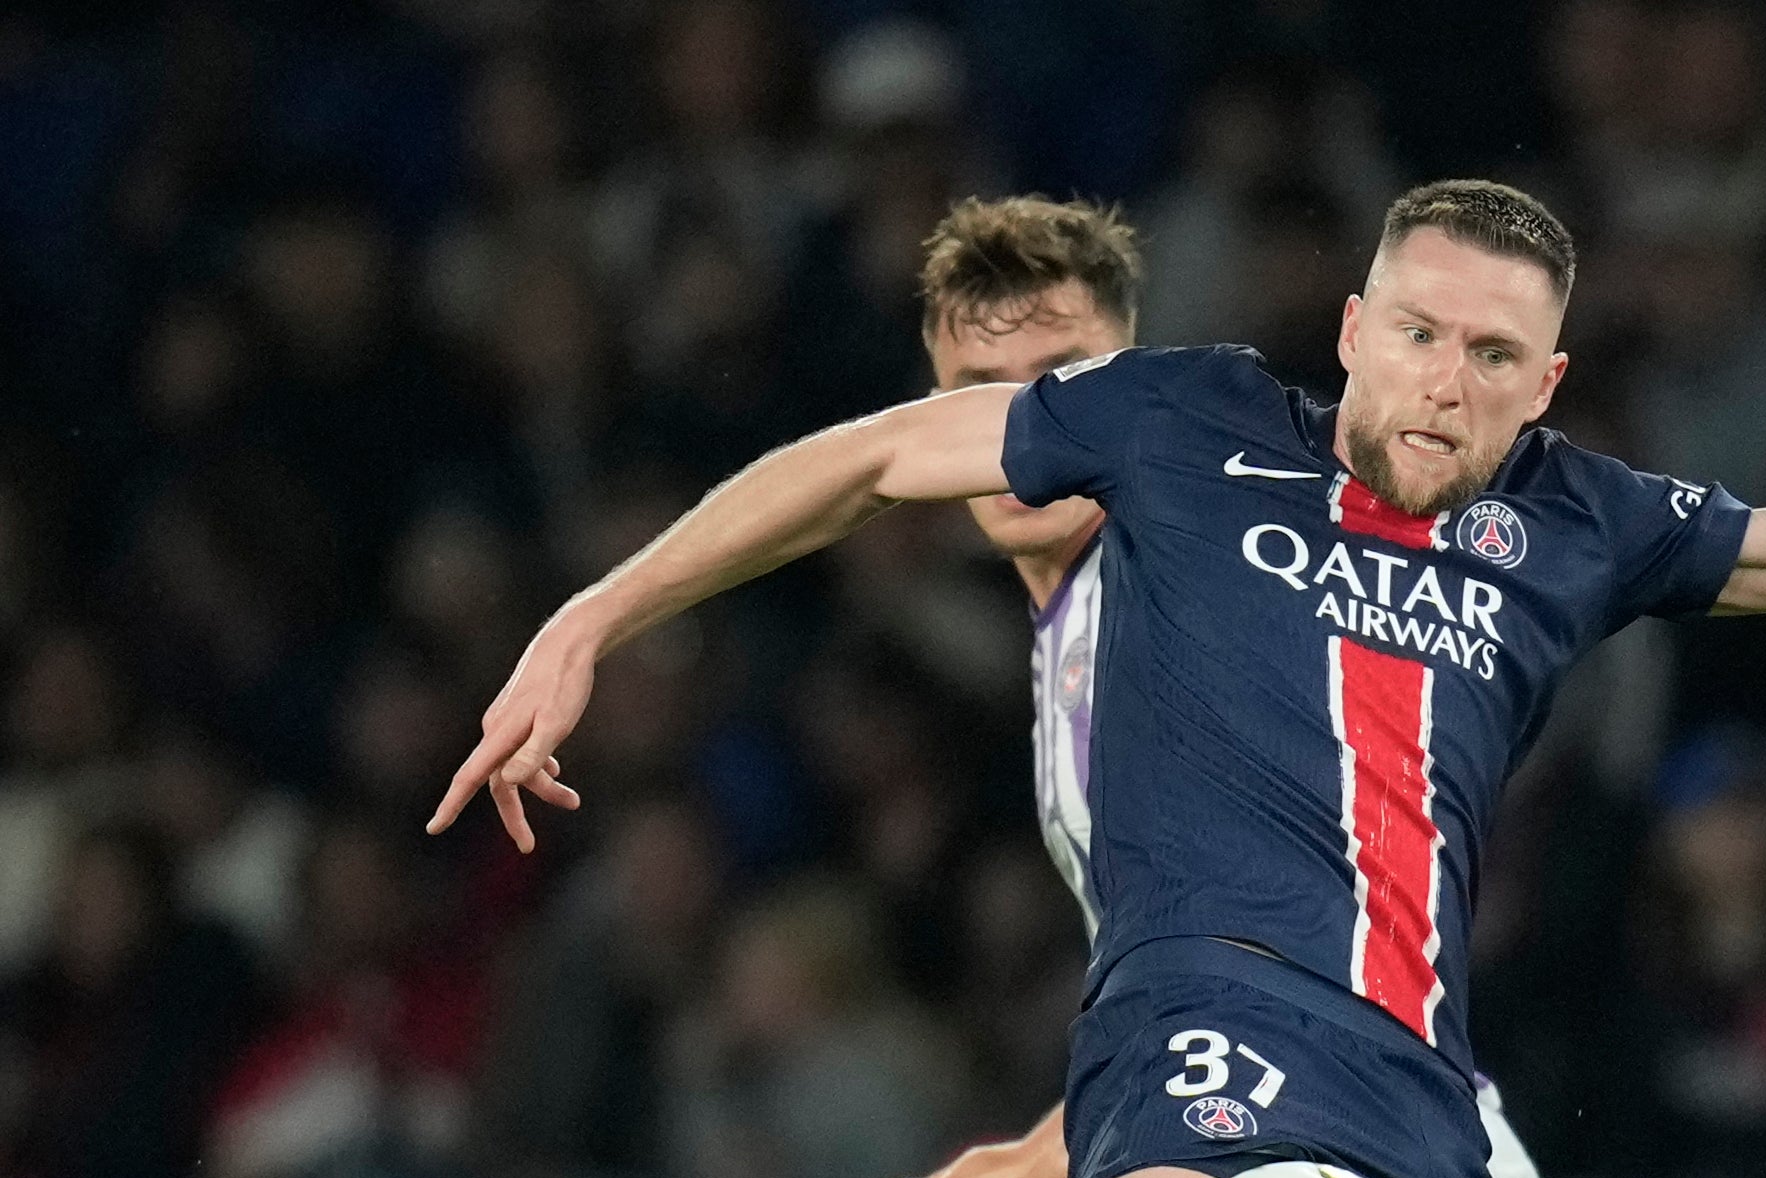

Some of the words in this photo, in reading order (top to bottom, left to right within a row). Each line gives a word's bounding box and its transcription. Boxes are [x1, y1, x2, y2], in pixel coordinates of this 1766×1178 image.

[1470, 504, 1515, 526] PARIS
[1241, 523, 1504, 644] QATAR
[1315, 592, 1498, 680] AIRWAYS
[1165, 1029, 1286, 1108] 37
[1196, 1099, 1245, 1115] PARIS
